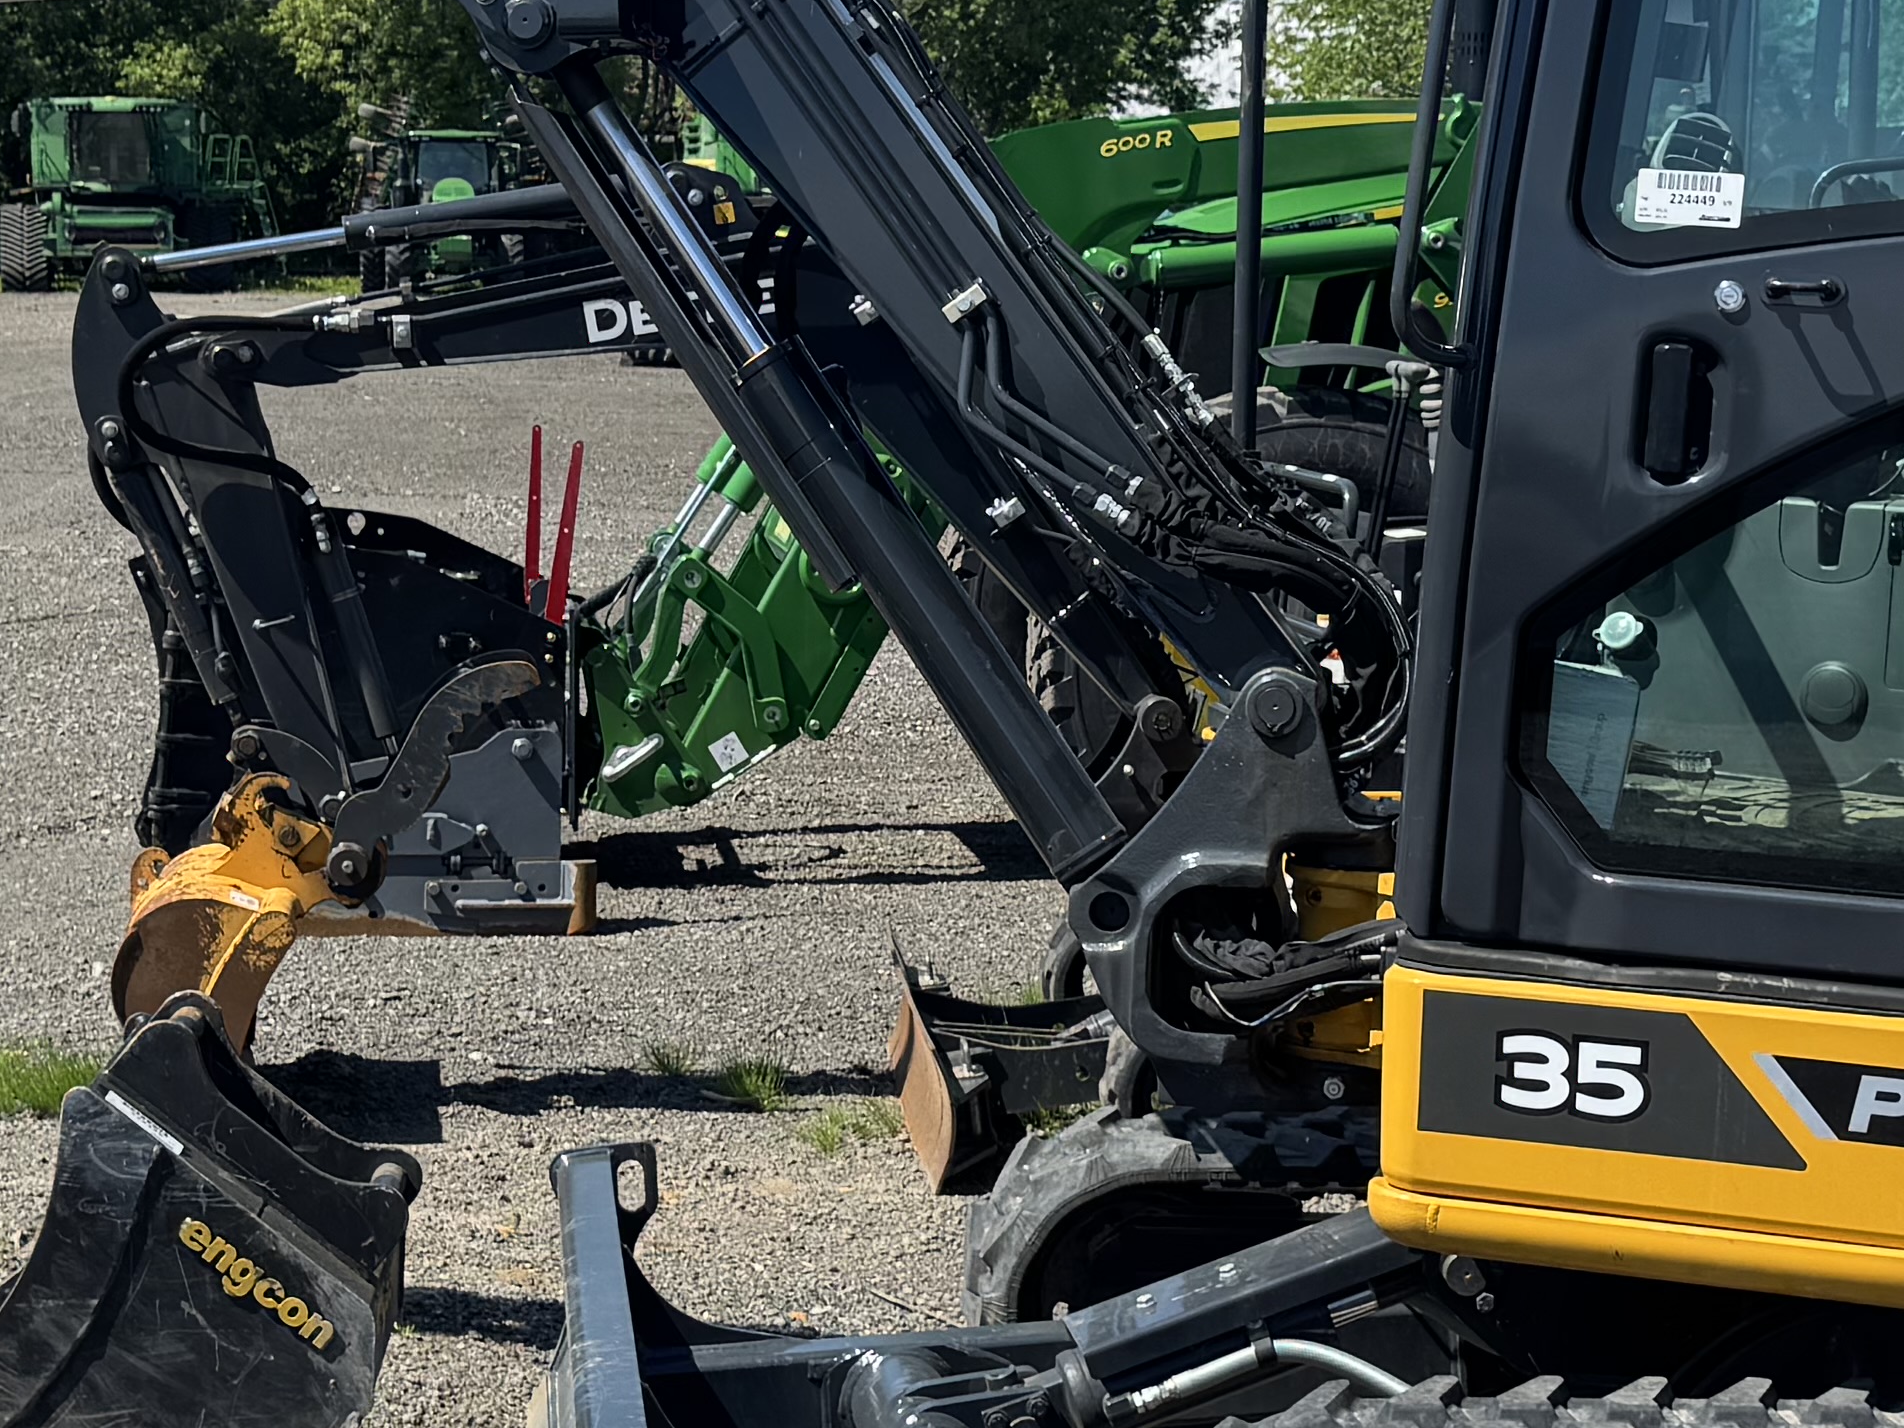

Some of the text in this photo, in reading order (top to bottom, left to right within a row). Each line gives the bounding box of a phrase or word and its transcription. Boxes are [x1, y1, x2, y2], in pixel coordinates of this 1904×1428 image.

[1669, 193, 1716, 206] 224449
[1499, 1033, 1646, 1118] 35
[178, 1216, 335, 1351] engcon
